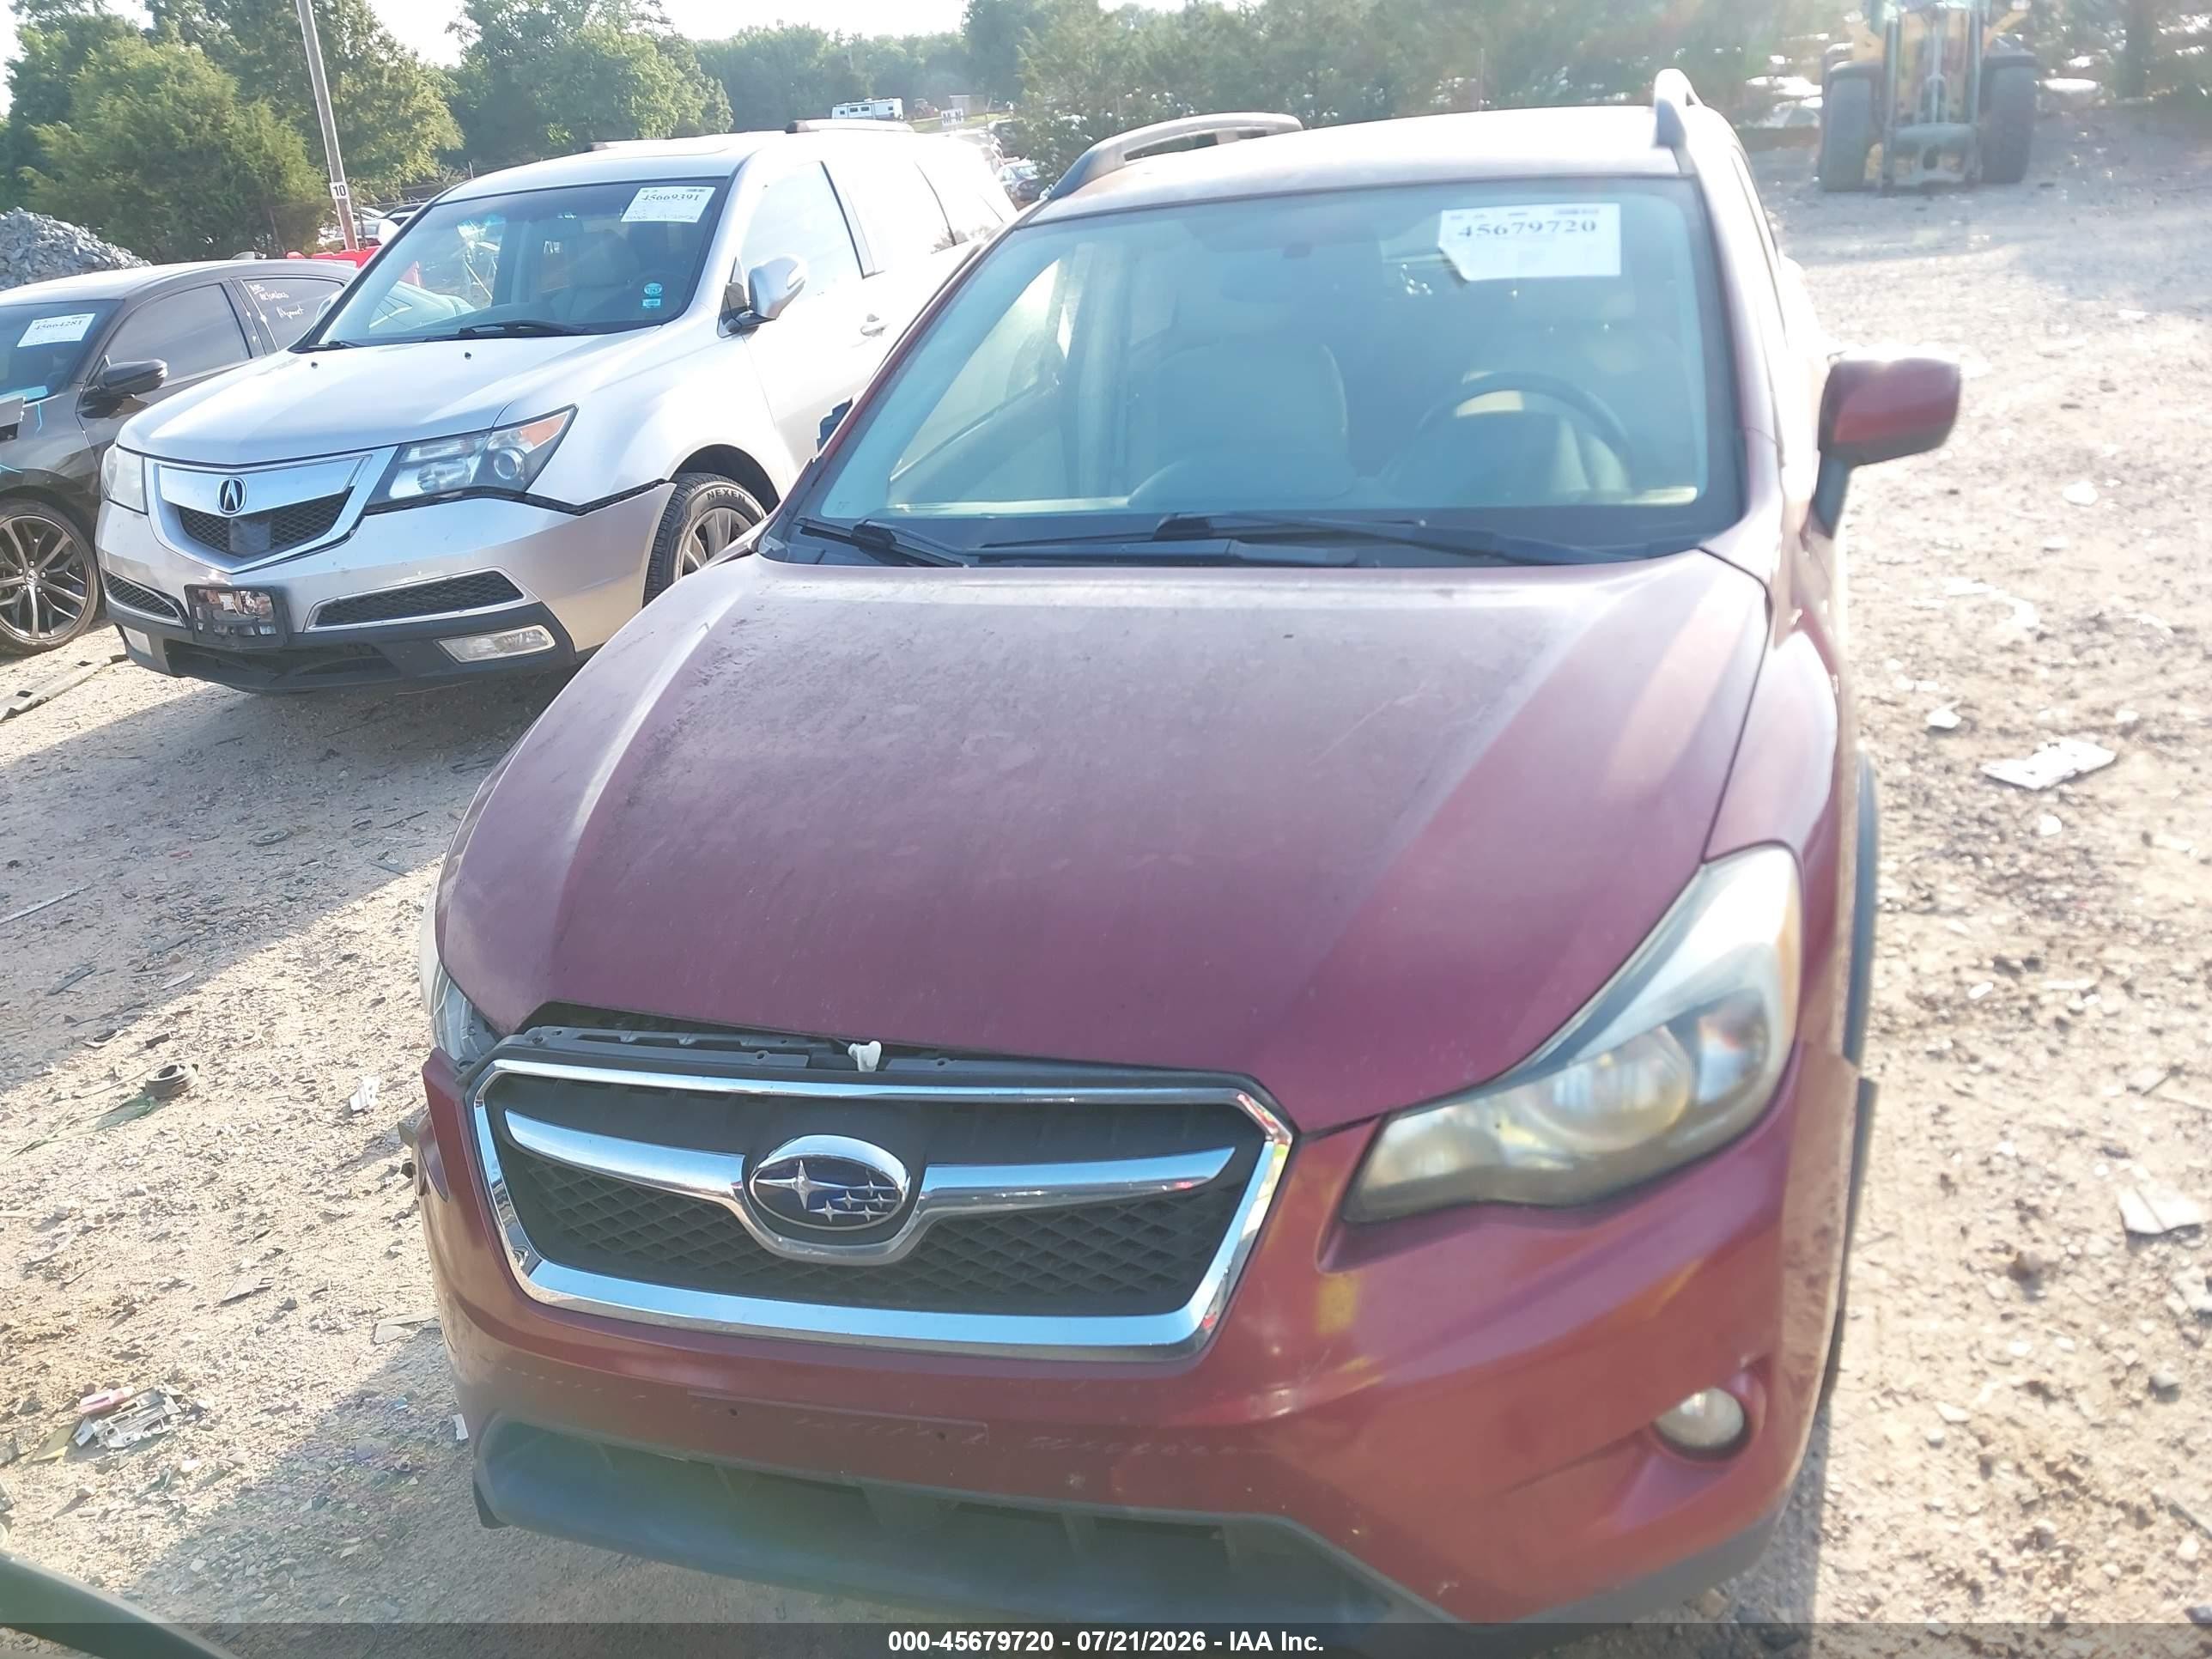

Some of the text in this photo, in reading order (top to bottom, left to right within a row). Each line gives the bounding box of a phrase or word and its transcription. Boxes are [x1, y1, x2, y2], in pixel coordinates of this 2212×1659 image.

[332, 185, 346, 196] 10
[1457, 220, 1596, 237] 45679720
[707, 489, 745, 502] NEXEN
